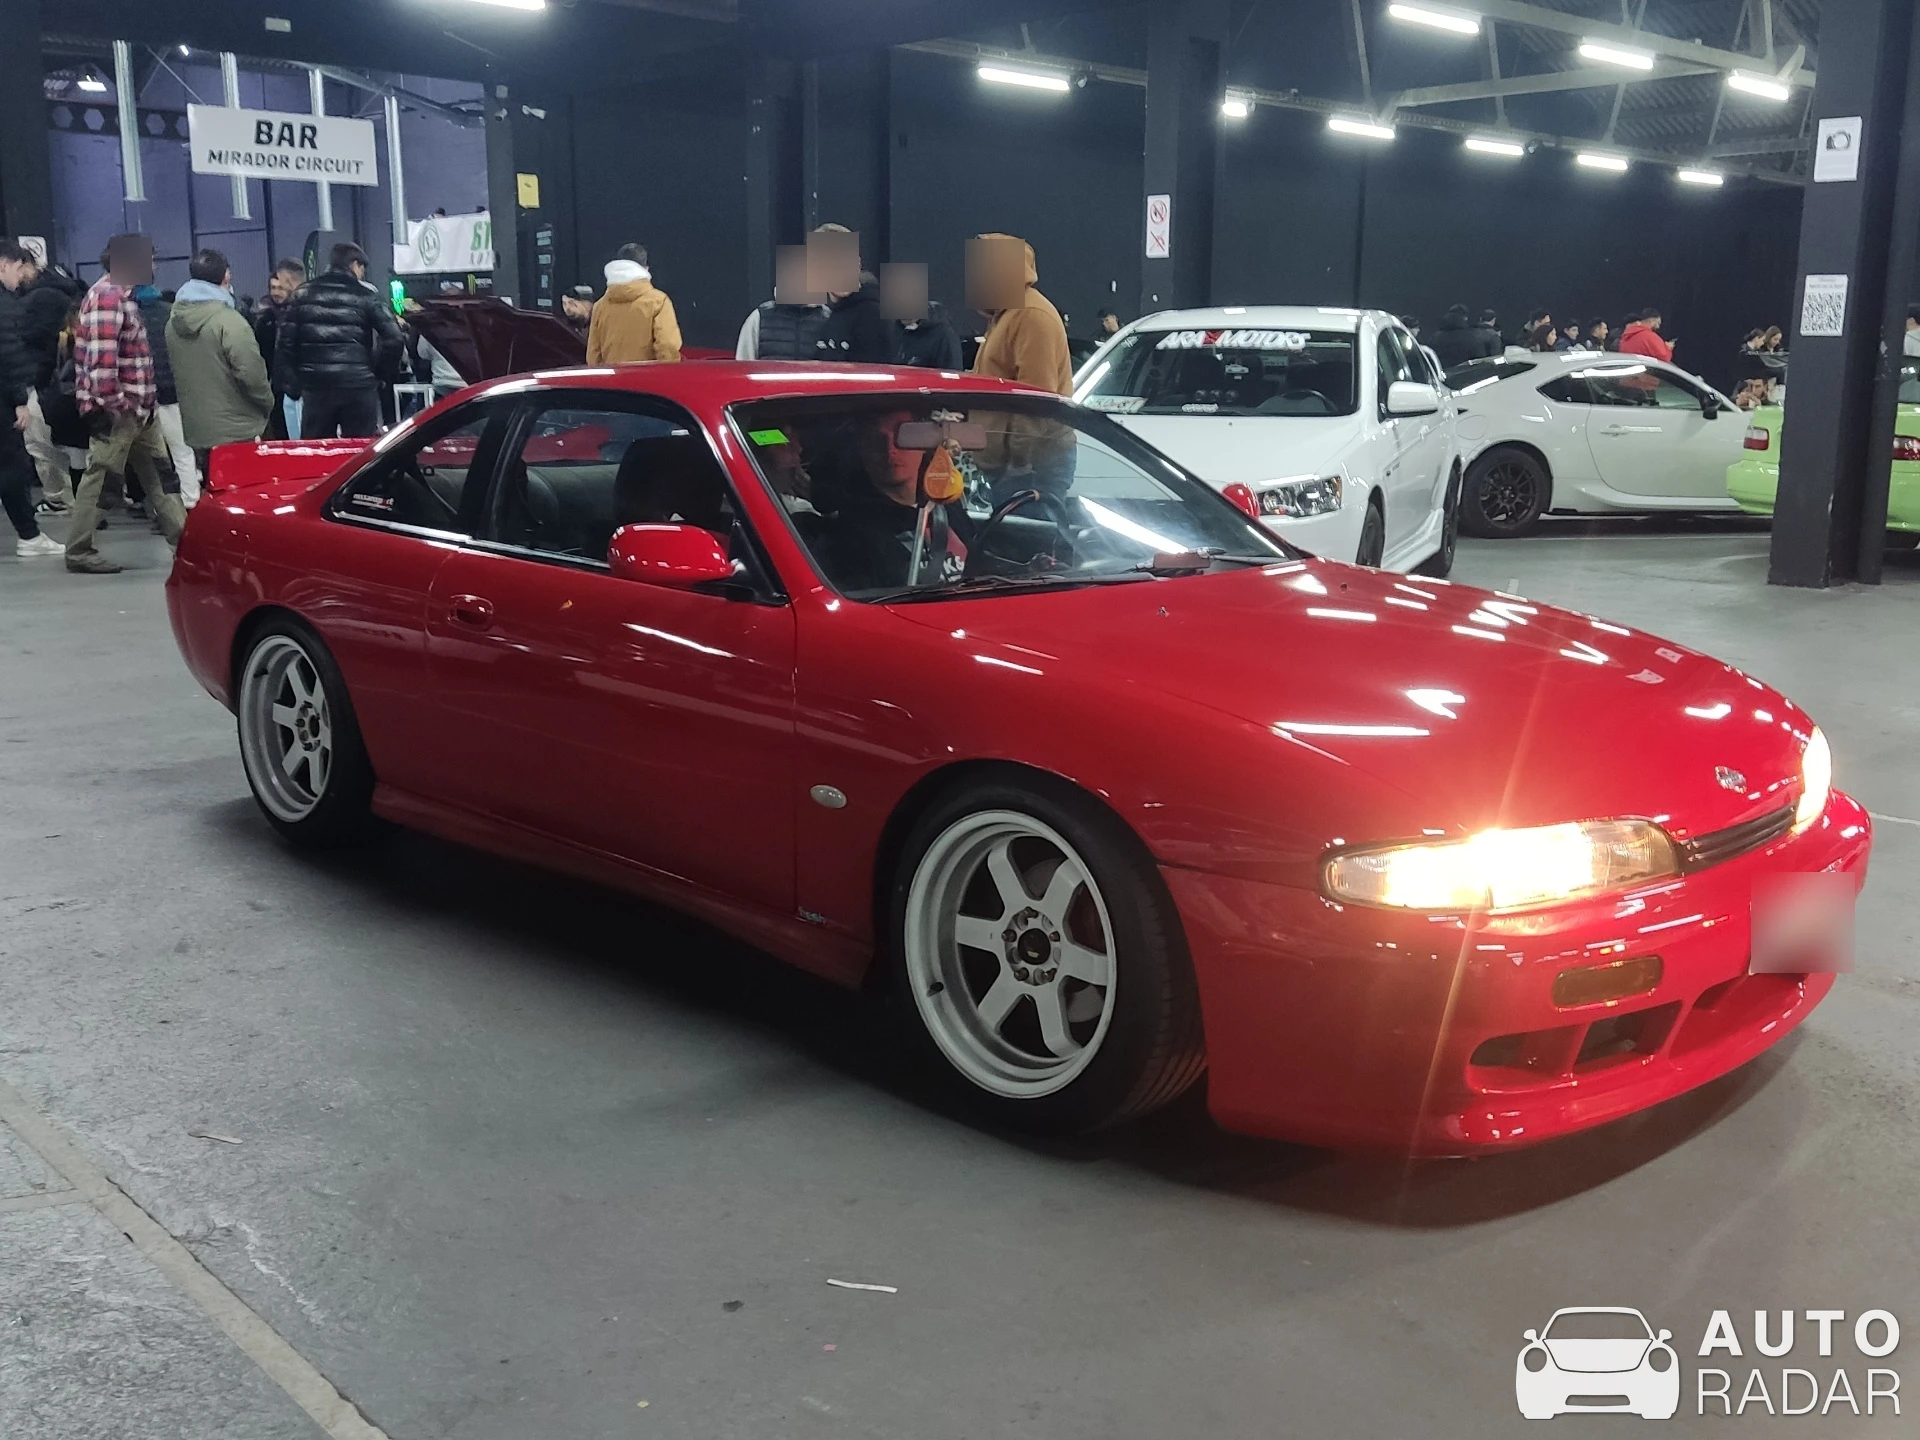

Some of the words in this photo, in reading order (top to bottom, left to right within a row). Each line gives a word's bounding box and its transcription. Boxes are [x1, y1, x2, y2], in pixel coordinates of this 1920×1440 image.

[255, 119, 318, 150] BAR
[207, 149, 290, 169] MIRADOR
[295, 155, 363, 175] CIRCUIT
